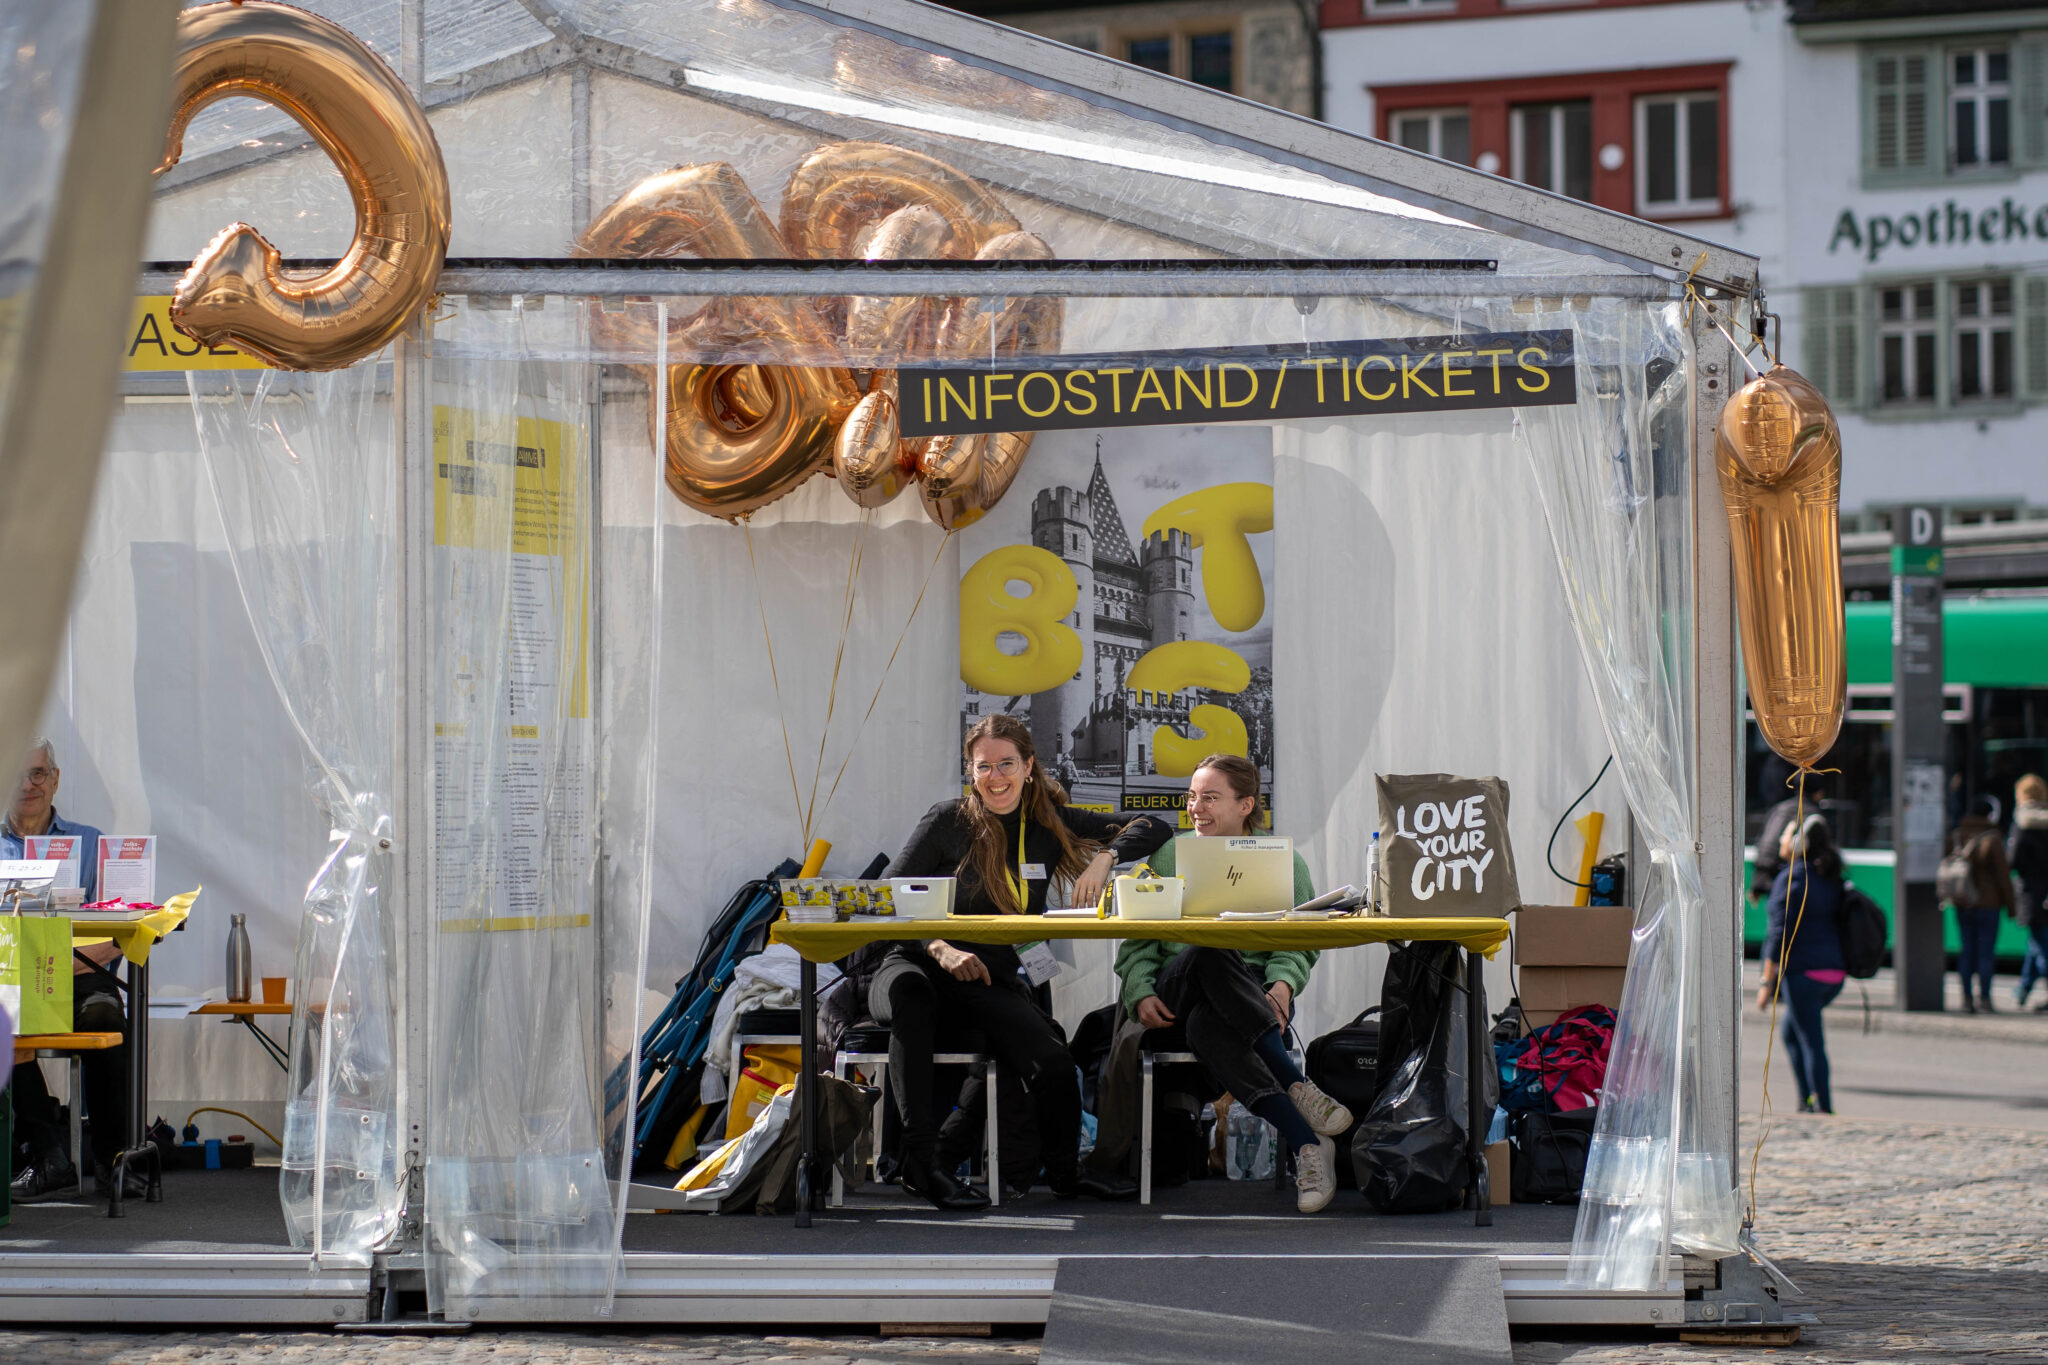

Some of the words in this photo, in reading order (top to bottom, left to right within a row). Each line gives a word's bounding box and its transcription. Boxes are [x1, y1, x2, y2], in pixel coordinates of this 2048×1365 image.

[923, 363, 1259, 423] INFOSTAND
[1301, 347, 1550, 402] TICKETS
[1911, 508, 1934, 545] D
[1125, 796, 1168, 808] FEUER
[1396, 795, 1486, 839] LOVE
[1230, 839, 1256, 847] grimm
[1416, 830, 1486, 857] YOUR
[1411, 849, 1494, 900] CITY
